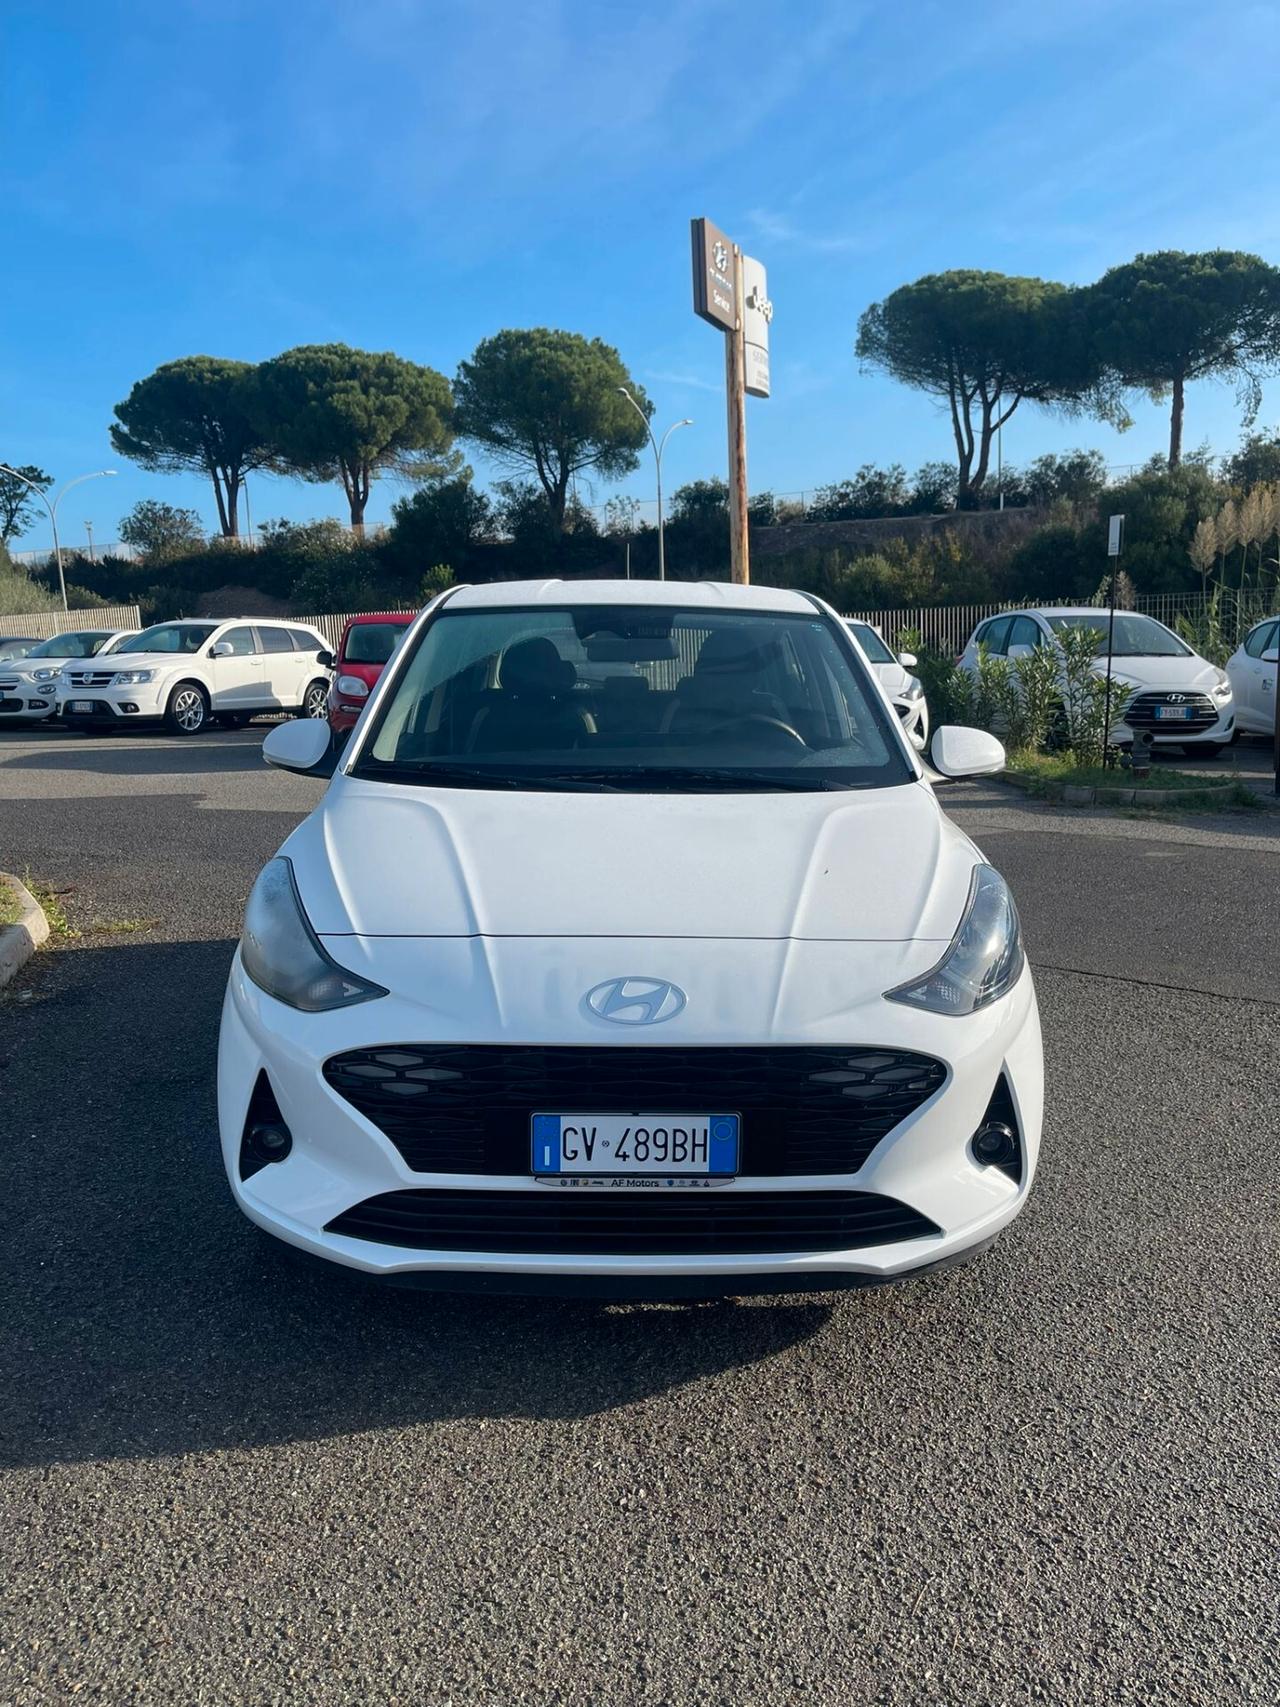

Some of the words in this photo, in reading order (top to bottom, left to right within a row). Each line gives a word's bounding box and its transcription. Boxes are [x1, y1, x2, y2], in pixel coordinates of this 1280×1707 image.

[562, 1126, 597, 1162] GV
[614, 1127, 708, 1163] 489BH
[611, 1179, 624, 1188] AF
[626, 1179, 660, 1188] Motors
